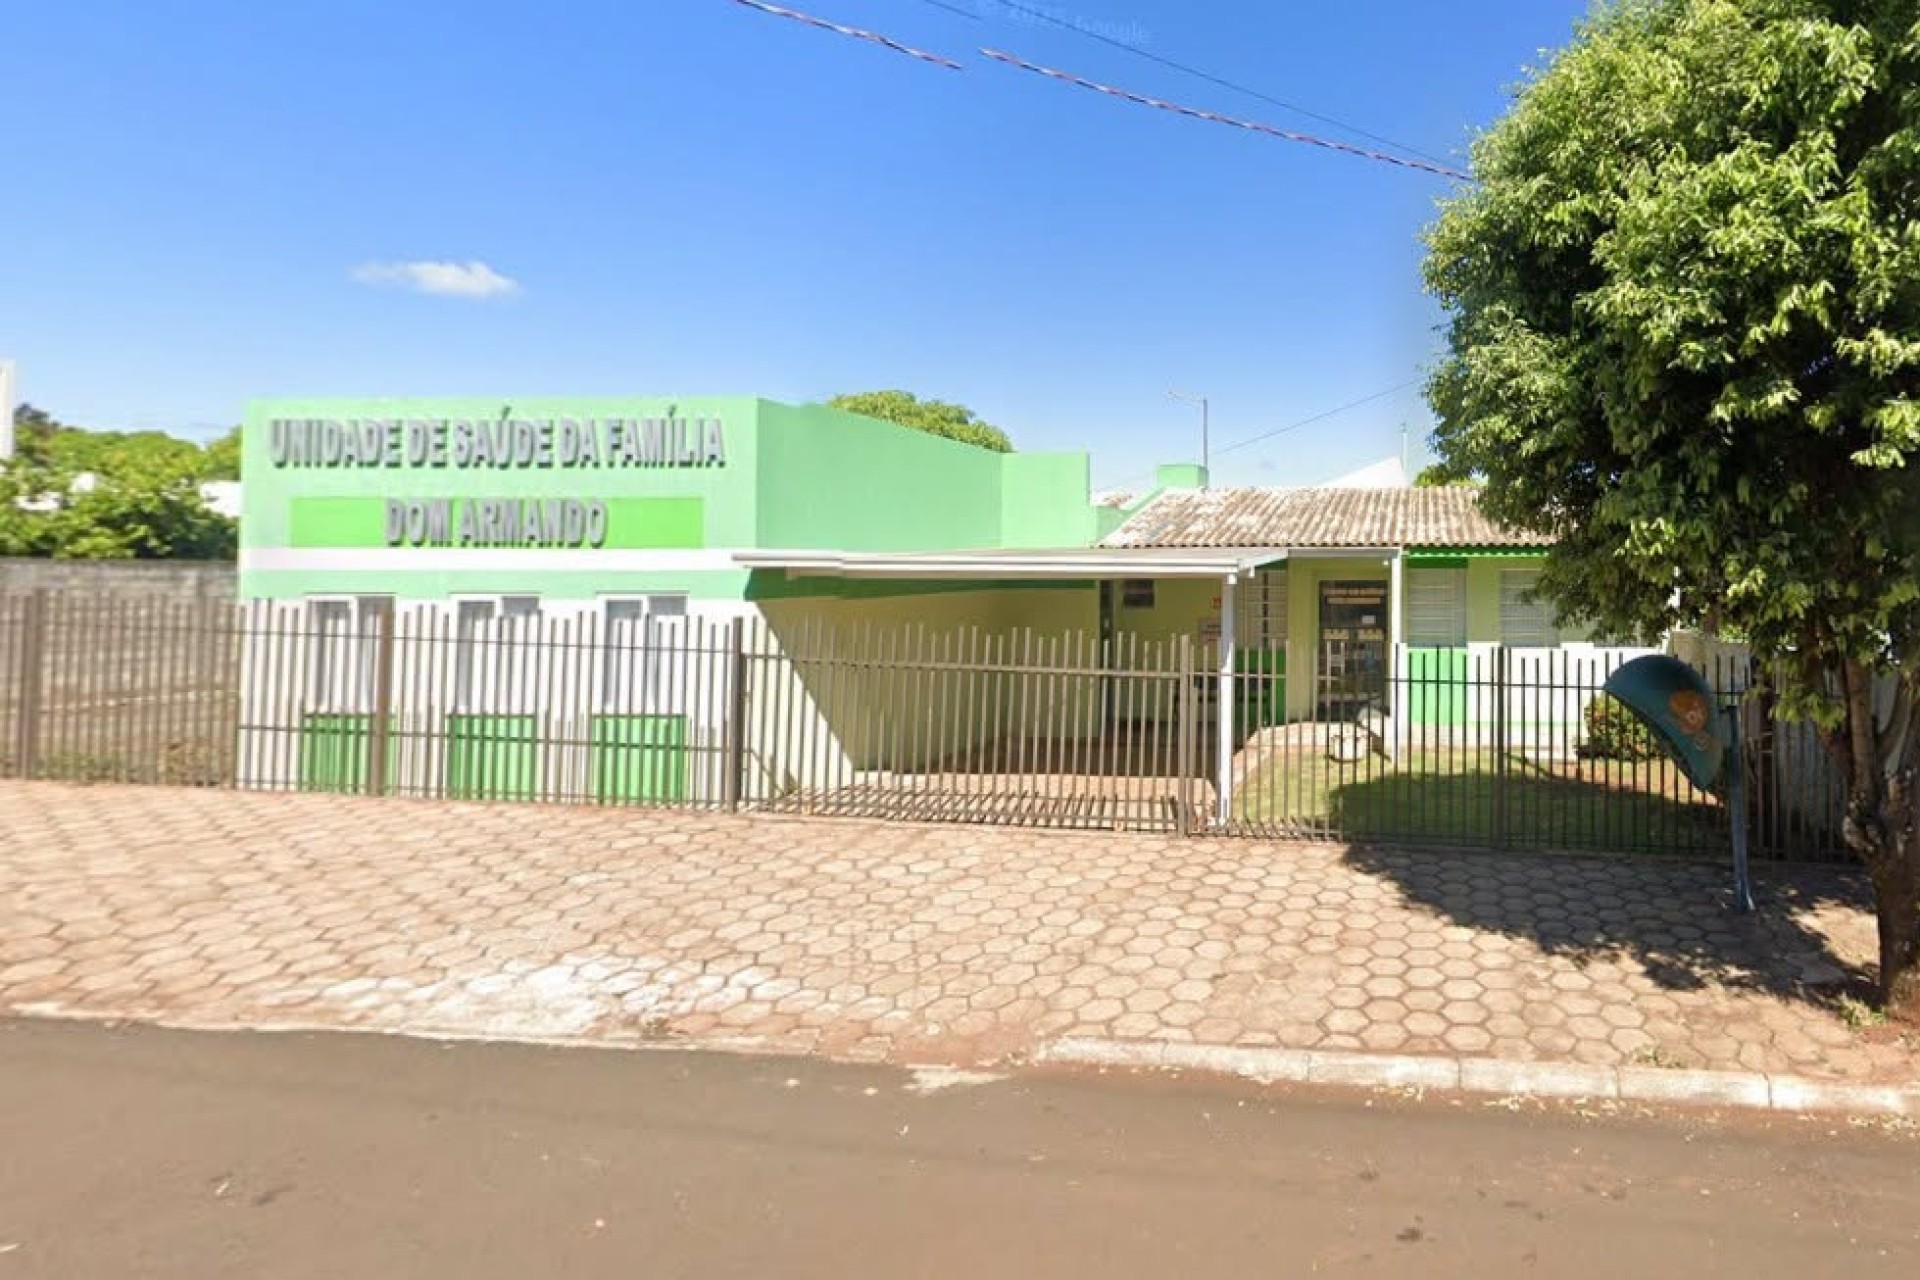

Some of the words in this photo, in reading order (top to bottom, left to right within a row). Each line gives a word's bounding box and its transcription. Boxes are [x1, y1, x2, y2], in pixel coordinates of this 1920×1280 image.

[270, 418, 401, 468] UNIDADE
[406, 418, 448, 468] DE
[453, 406, 553, 470] SAÚDE
[559, 418, 600, 468] DA
[606, 404, 725, 468] FAMÍLIA
[386, 498, 453, 548] DOM
[459, 498, 608, 549] ARMANDO
